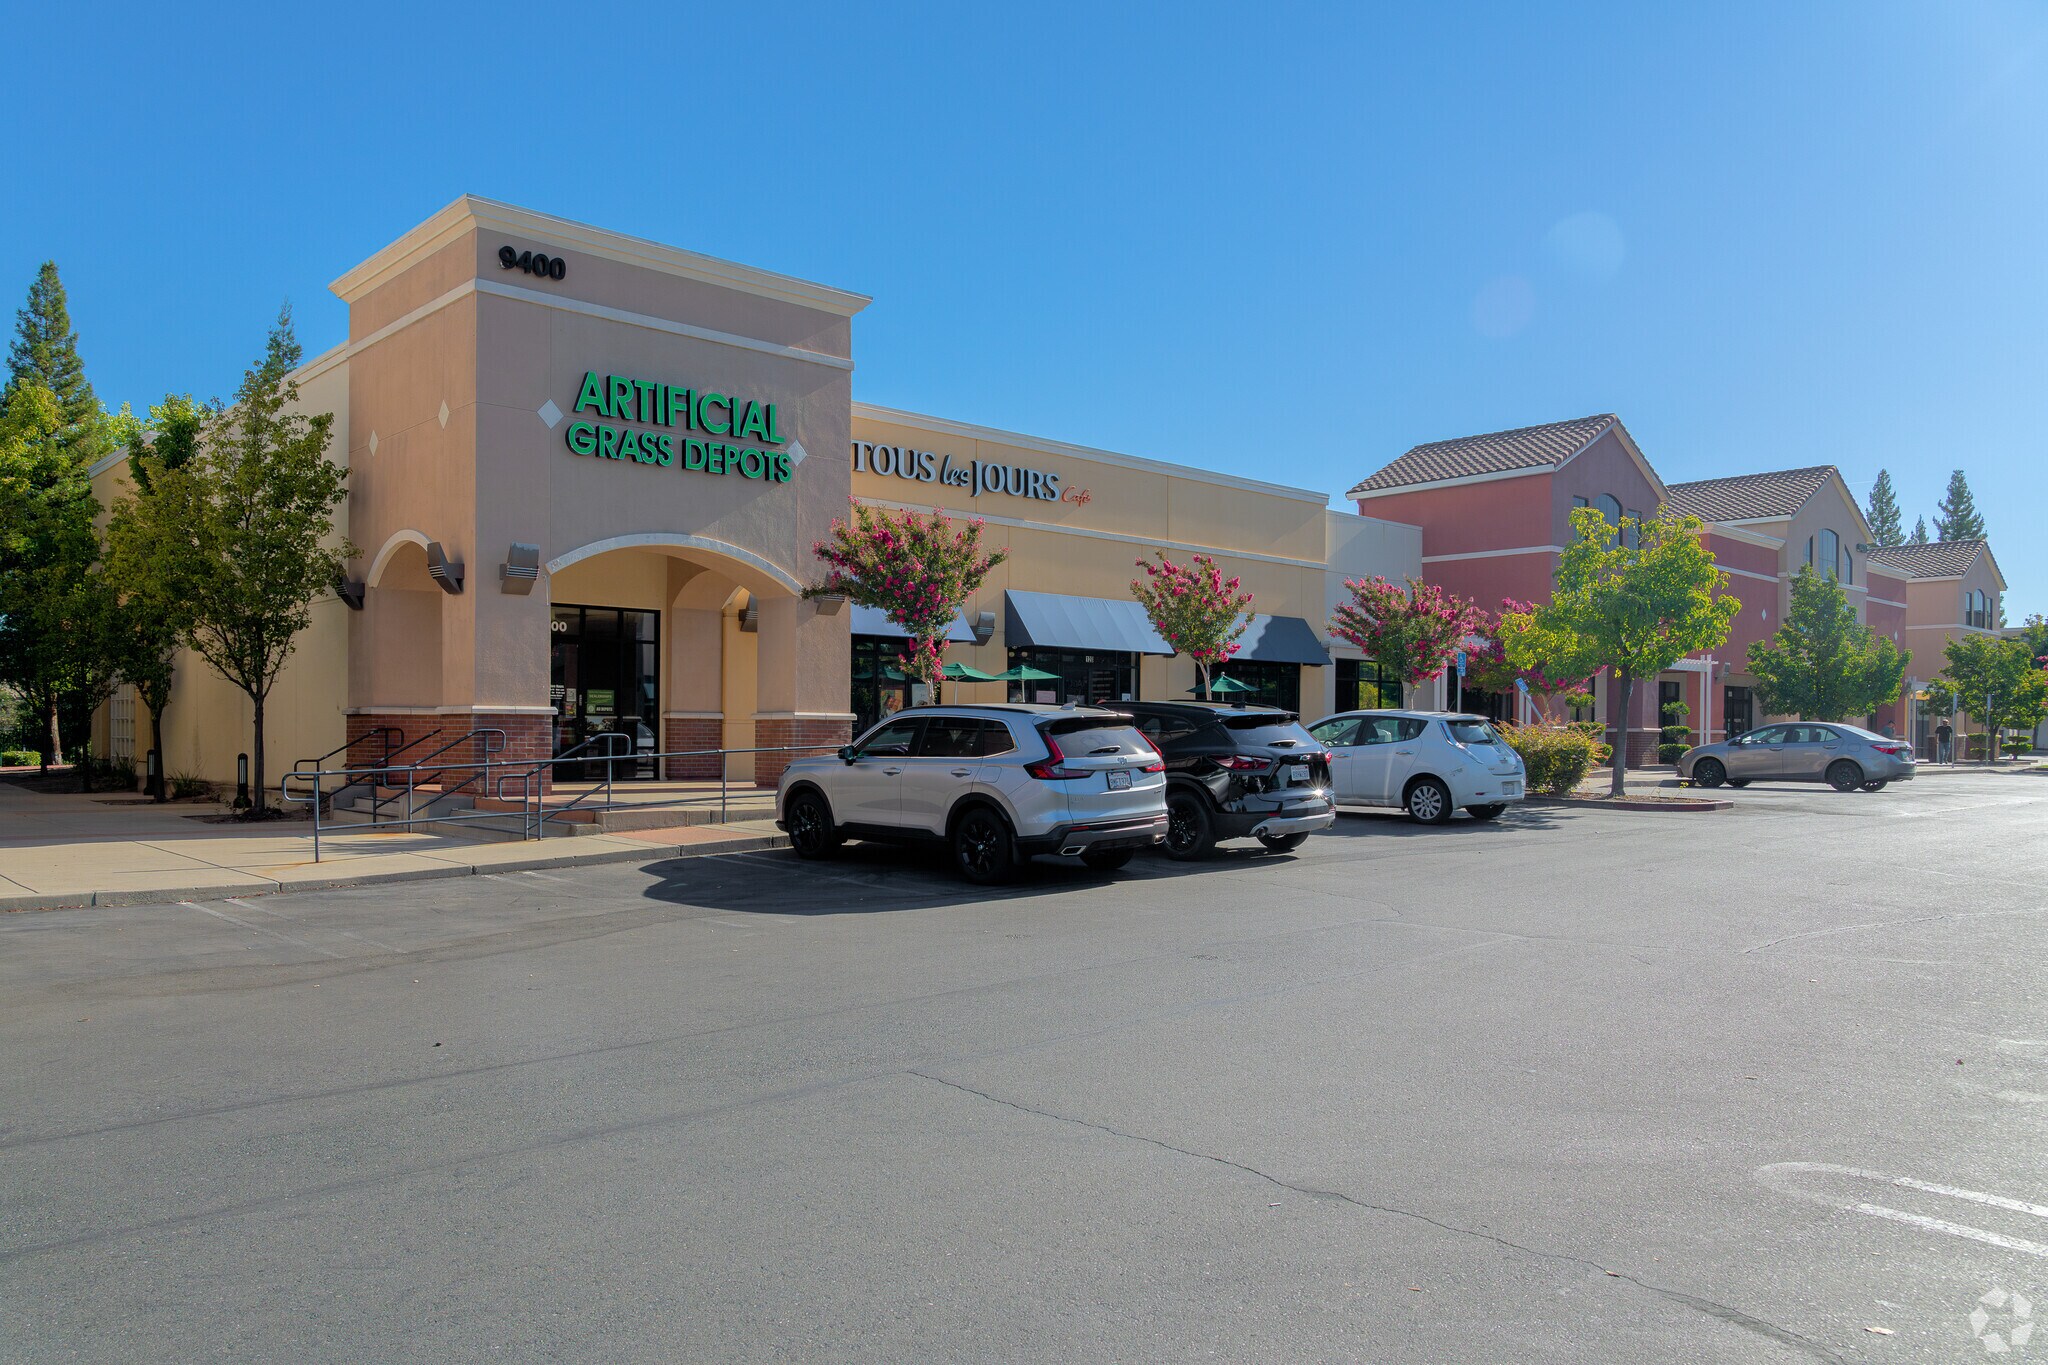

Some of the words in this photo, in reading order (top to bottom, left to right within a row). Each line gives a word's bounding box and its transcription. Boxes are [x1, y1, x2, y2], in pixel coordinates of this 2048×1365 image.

[498, 245, 567, 280] 9400
[573, 370, 786, 444] ARTIFICIAL
[566, 421, 675, 467] GRASS
[682, 438, 793, 483] DEPOTS
[850, 440, 937, 483] TOUS
[940, 454, 970, 488] les
[970, 460, 1061, 502] JOURS
